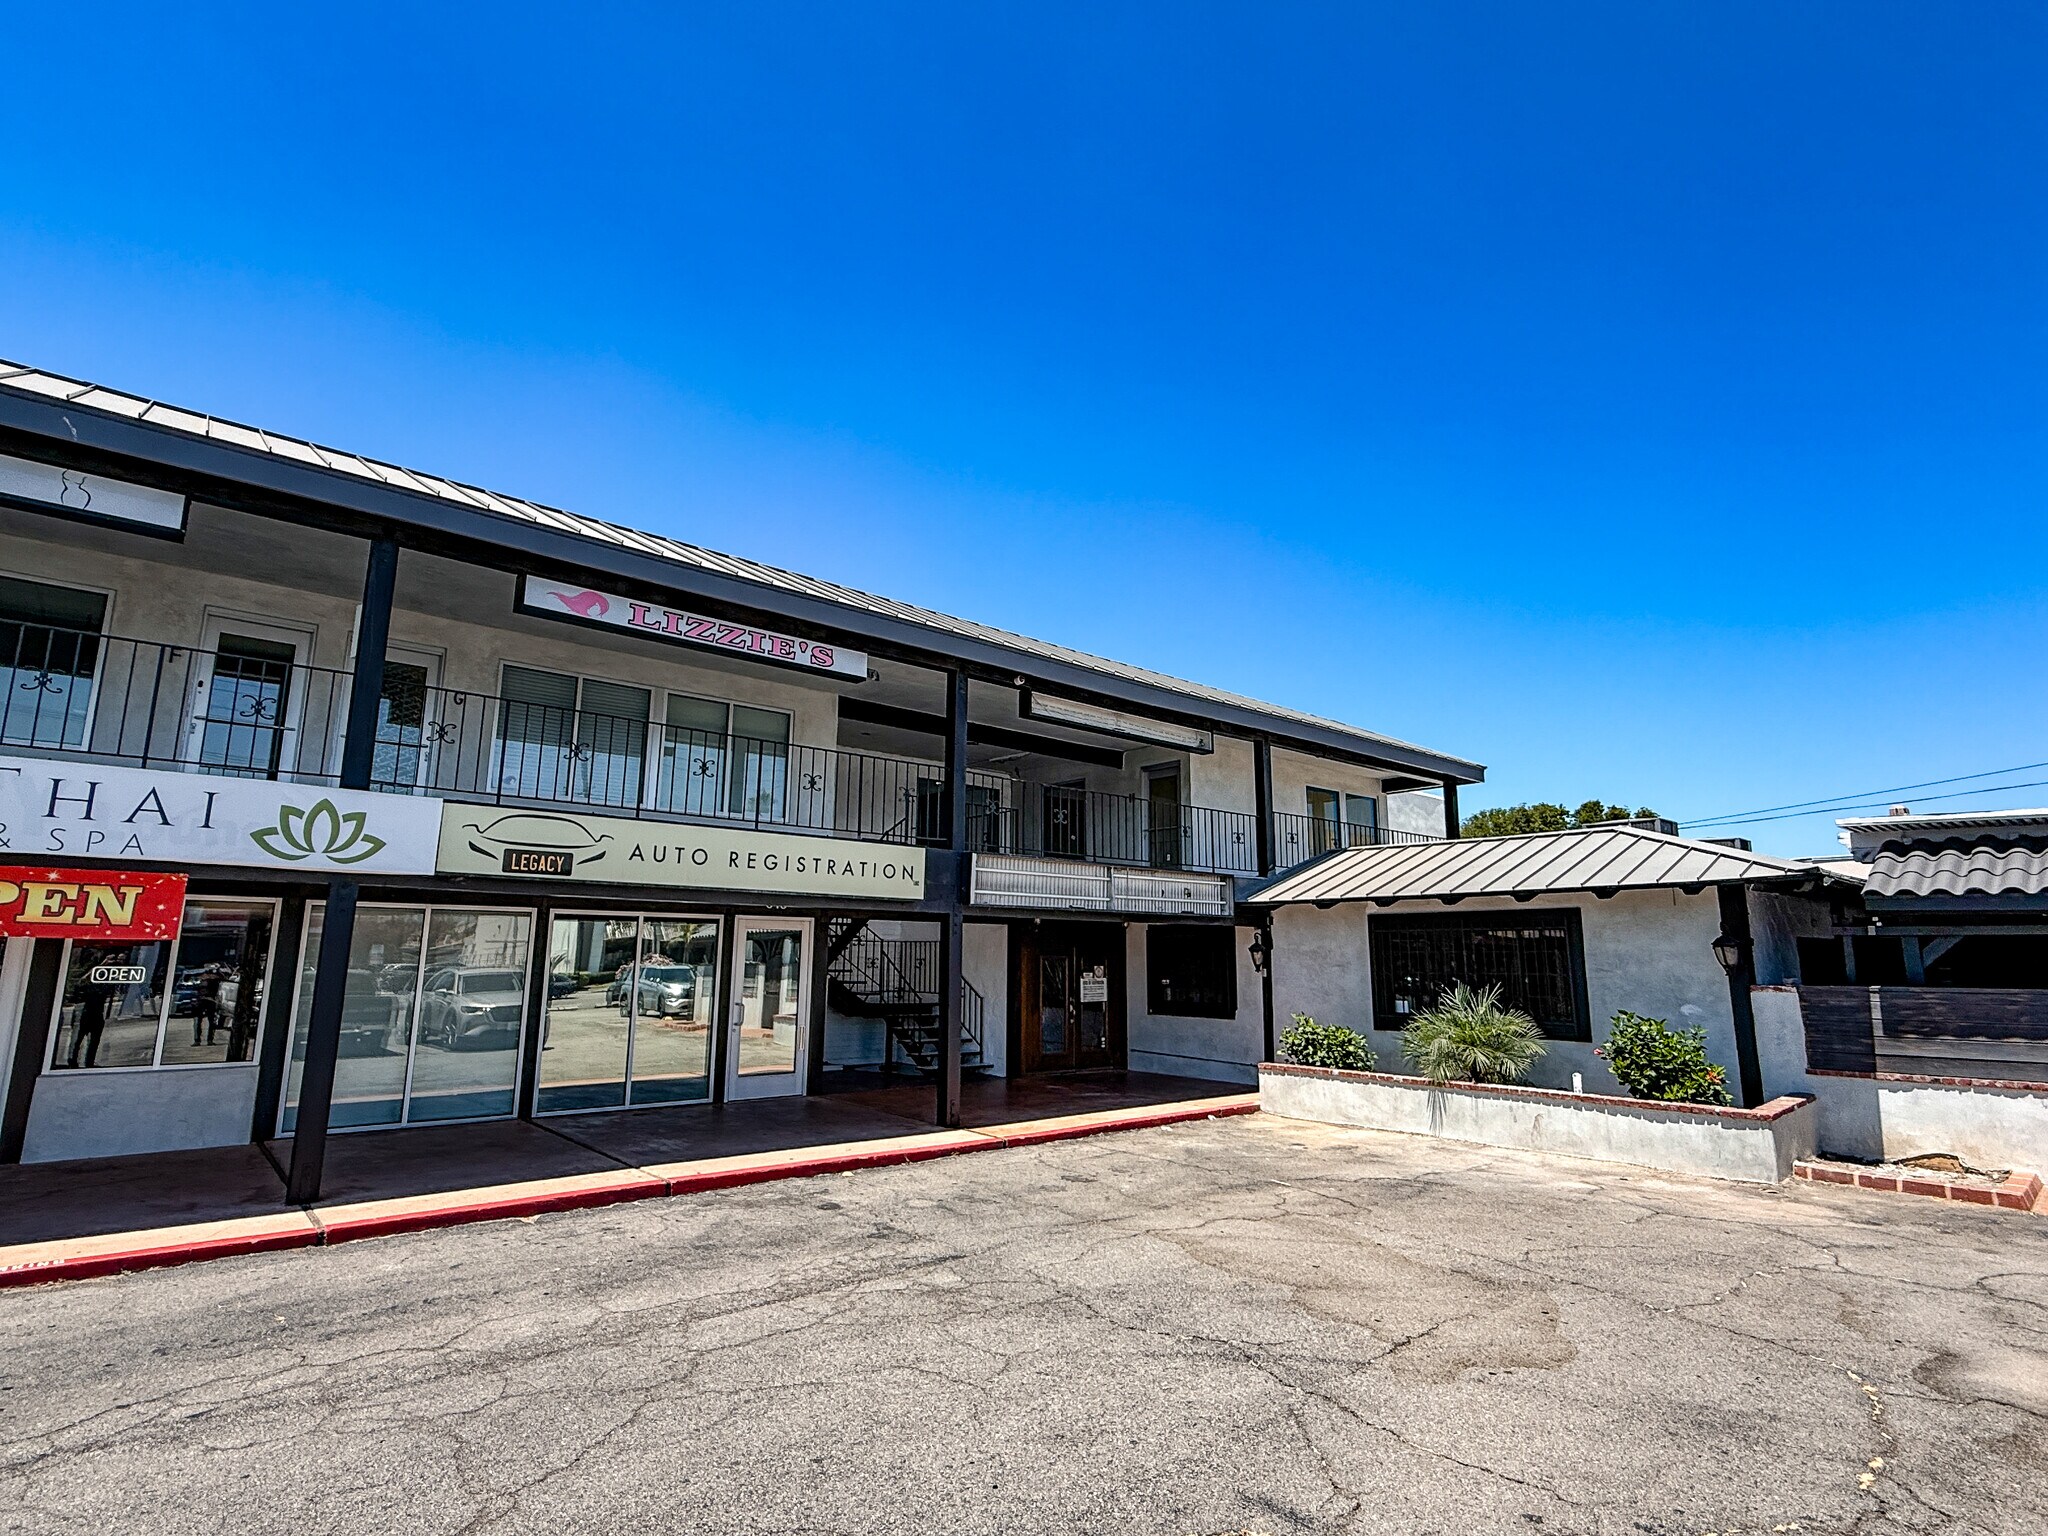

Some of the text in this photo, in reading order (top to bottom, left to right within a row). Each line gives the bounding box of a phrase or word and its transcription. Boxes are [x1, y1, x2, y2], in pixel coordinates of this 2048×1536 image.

[628, 602, 834, 667] LIZZIE'S
[46, 827, 145, 856] SPA
[510, 853, 565, 873] LEGACY
[628, 843, 914, 881] AUTO REGISTRATION
[95, 968, 141, 981] OPEN
